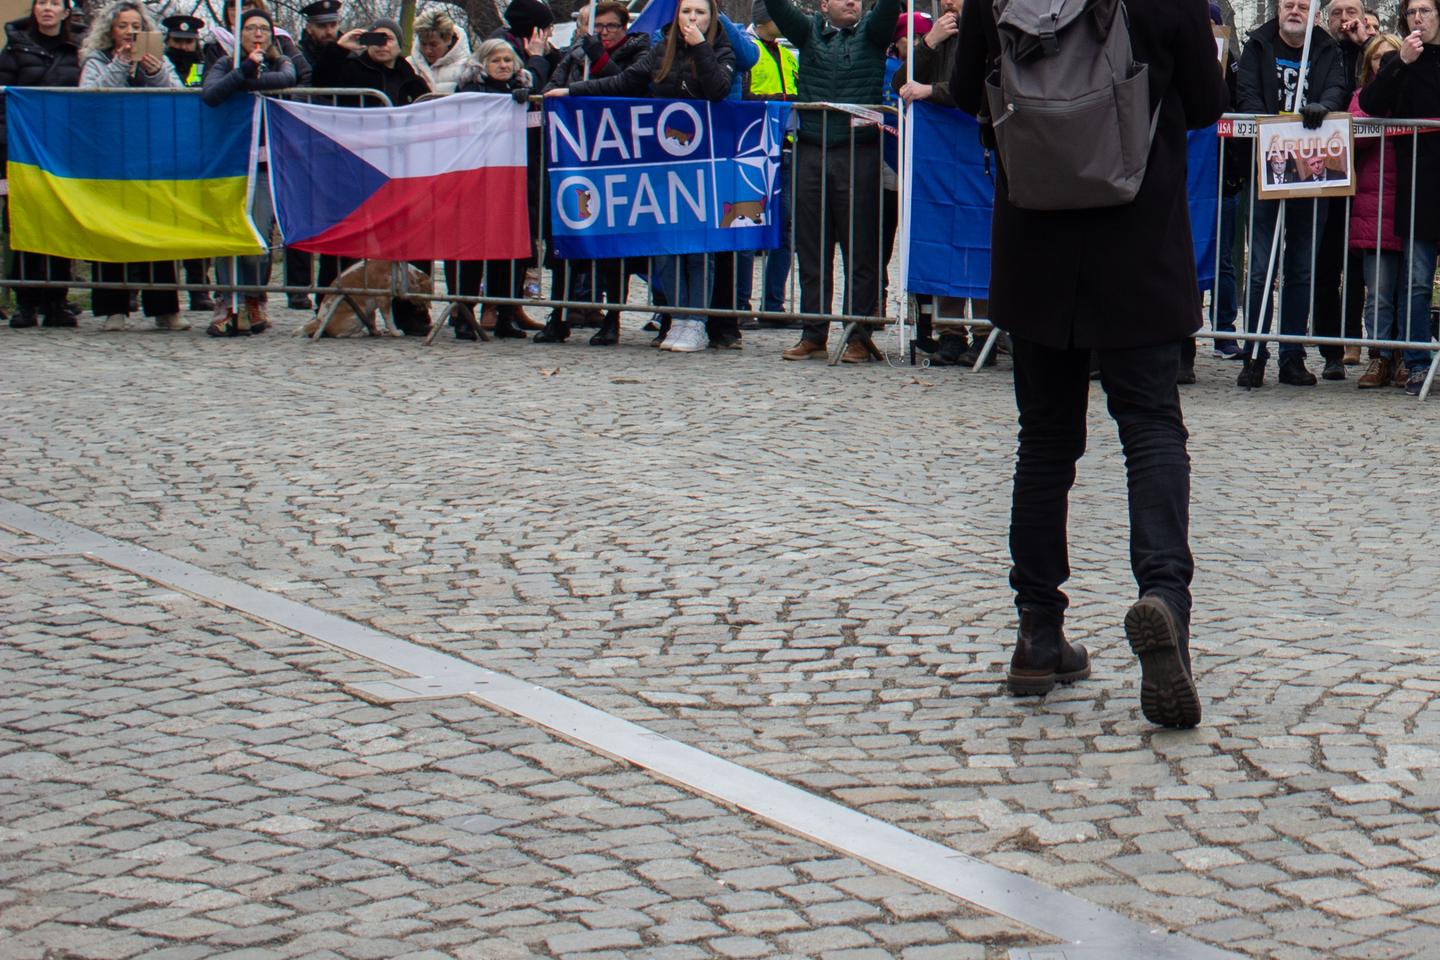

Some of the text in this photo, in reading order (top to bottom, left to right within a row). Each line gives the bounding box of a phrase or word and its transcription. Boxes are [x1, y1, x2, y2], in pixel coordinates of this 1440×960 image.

[548, 102, 703, 163] NAFO
[1266, 130, 1344, 161] ÁRULÓ
[556, 169, 707, 230] OFAN
